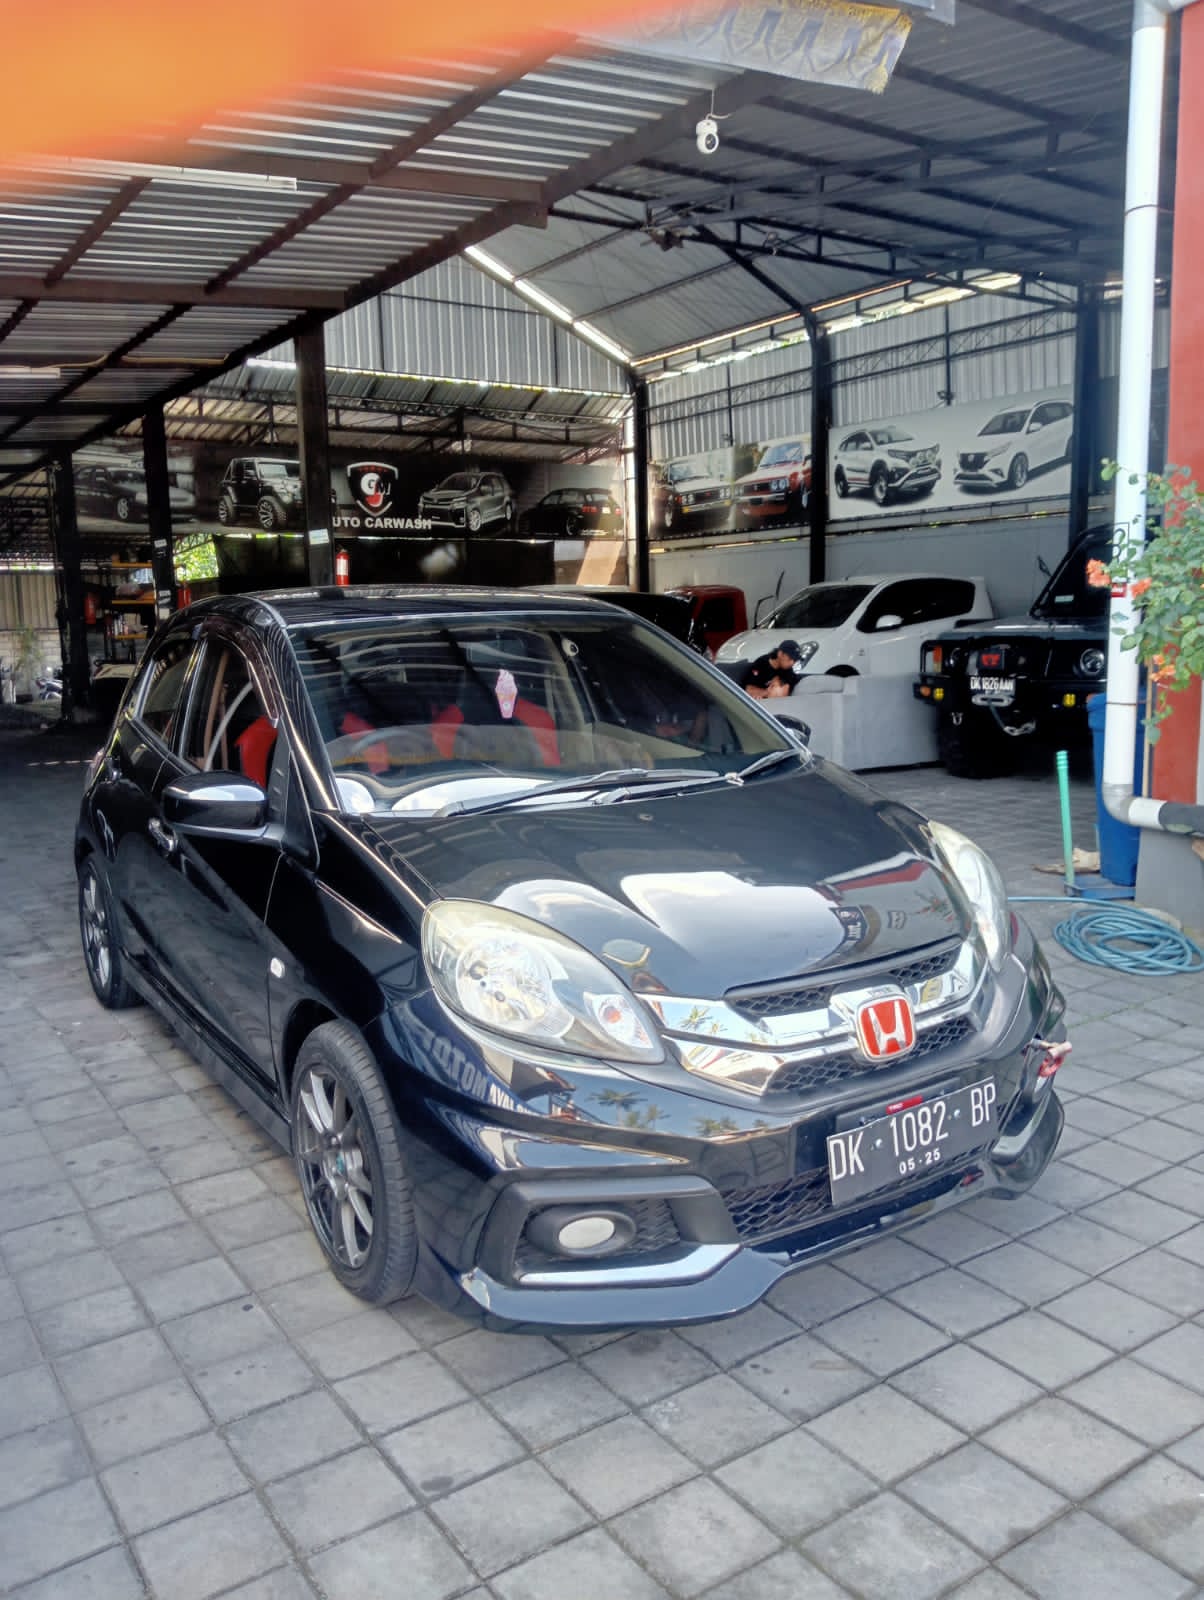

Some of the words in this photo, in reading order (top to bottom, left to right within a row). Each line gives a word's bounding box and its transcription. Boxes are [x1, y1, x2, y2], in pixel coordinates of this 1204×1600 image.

[332, 516, 361, 528] UTO
[364, 518, 432, 529] CARWASH
[829, 1131, 865, 1181] DK
[890, 1101, 949, 1157] 1082
[971, 1082, 996, 1128] BP
